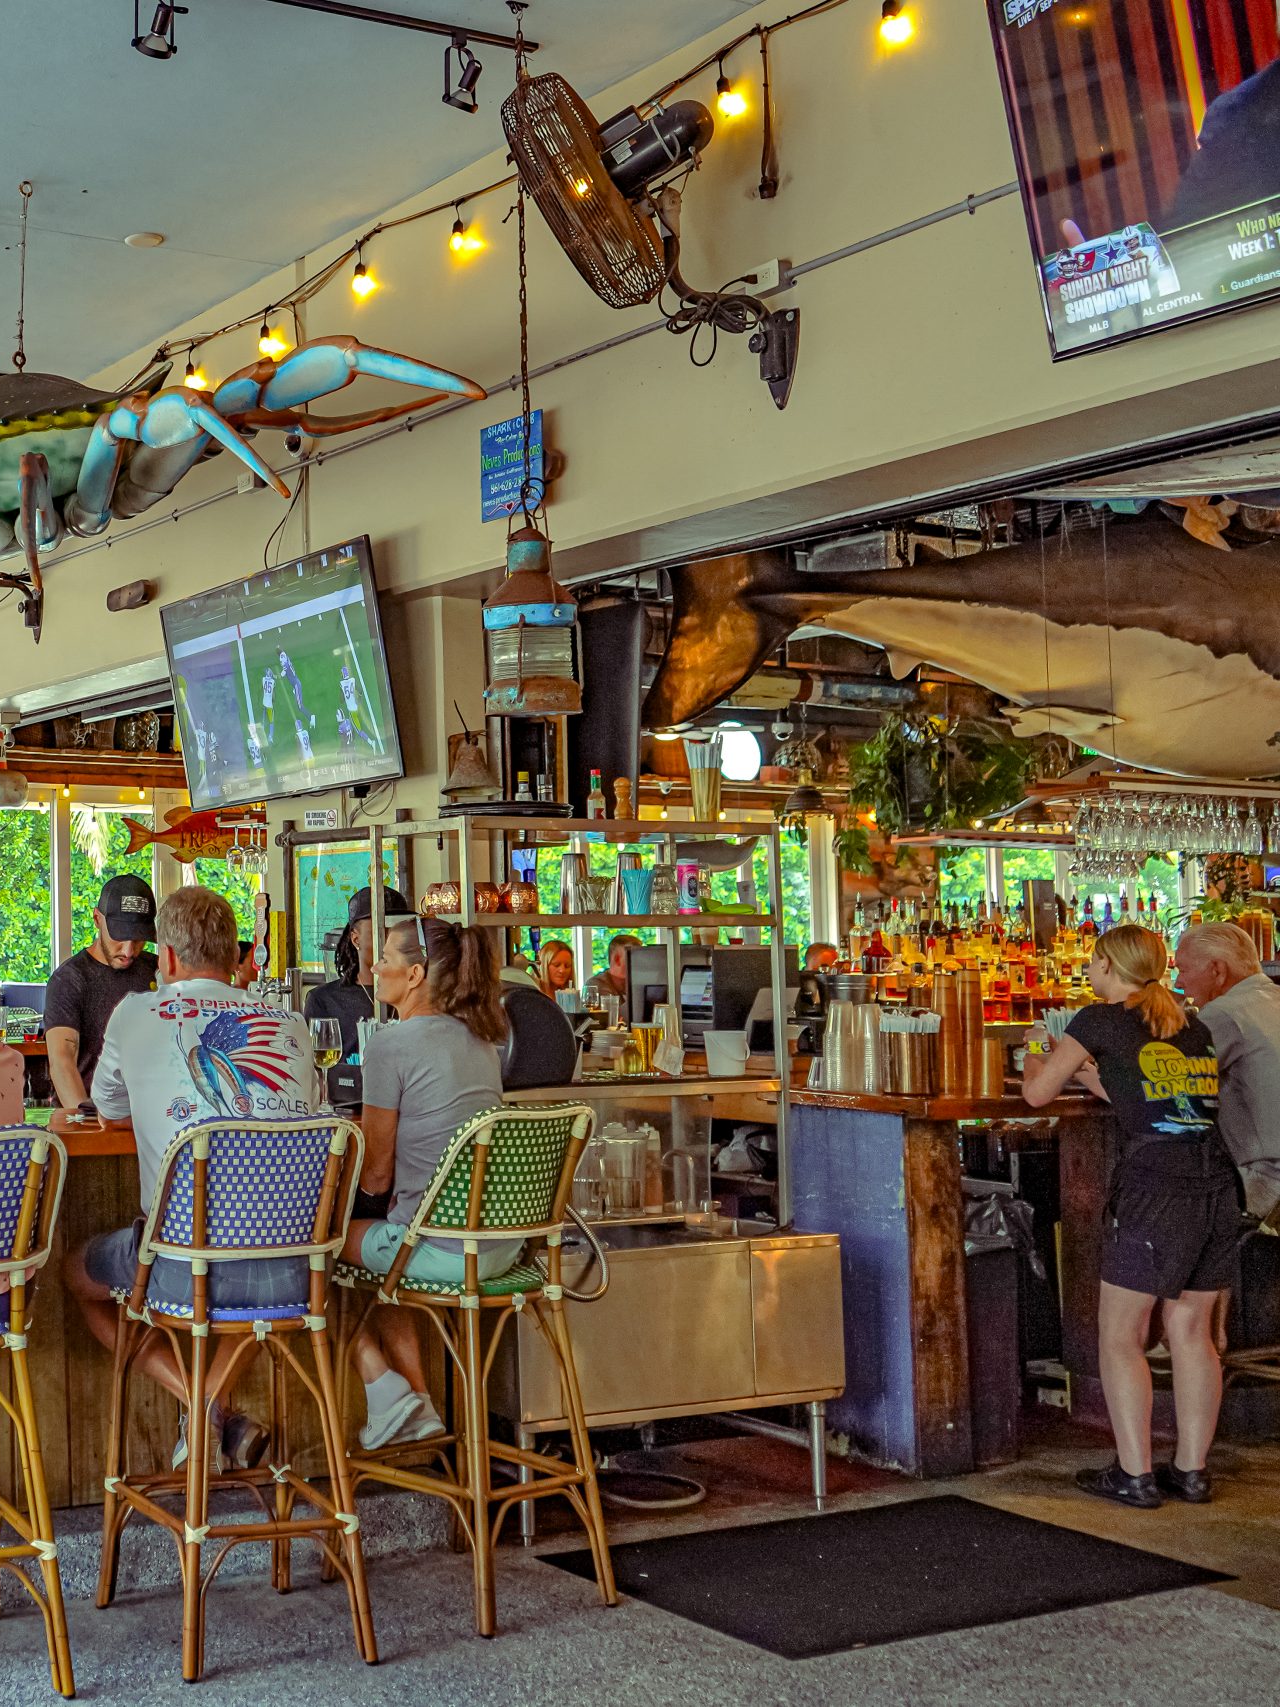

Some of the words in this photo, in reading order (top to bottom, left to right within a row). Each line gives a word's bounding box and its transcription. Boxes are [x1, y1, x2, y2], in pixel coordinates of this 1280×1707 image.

[1017, 12, 1032, 28] LIVE
[1236, 218, 1267, 238] WHO
[1228, 238, 1263, 260] WEEK
[1060, 269, 1110, 301] SUNDAY
[1108, 257, 1149, 288] NIGHT
[1230, 269, 1280, 291] Guardians
[1065, 278, 1152, 324] SHOWDOWN
[1142, 306, 1156, 317] AL
[1156, 291, 1204, 313] CENTRAL
[1088, 320, 1110, 333] MLB
[487, 420, 511, 438] SHARK
[503, 443, 541, 465] Producons
[256, 1098, 309, 1116] SCALES
